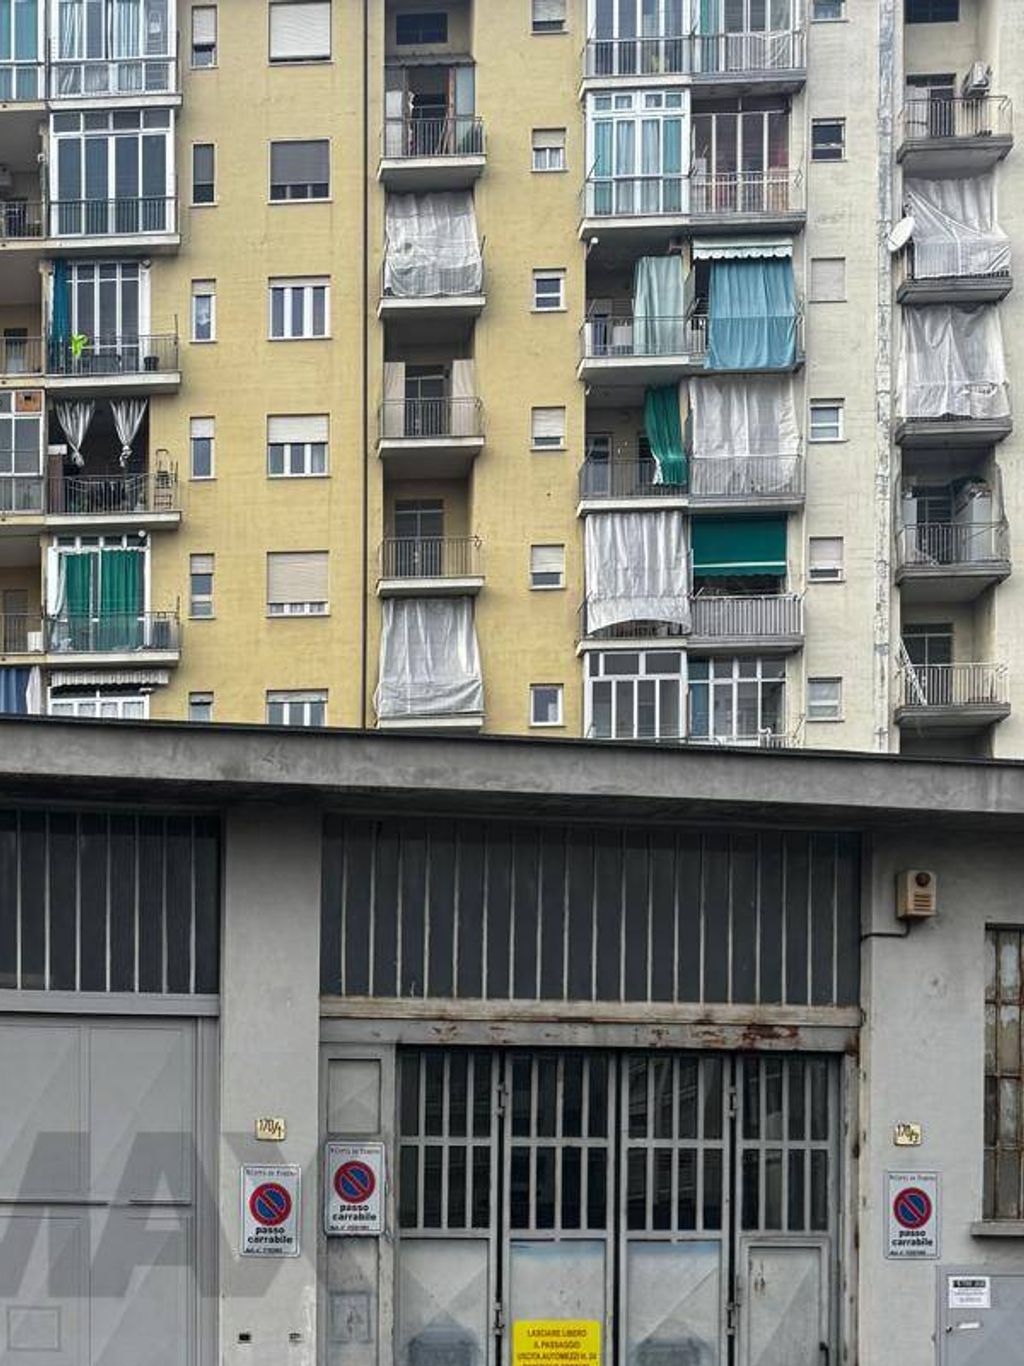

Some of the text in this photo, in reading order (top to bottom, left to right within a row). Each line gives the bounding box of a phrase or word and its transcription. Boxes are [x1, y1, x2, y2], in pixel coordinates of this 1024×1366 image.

[339, 1204, 370, 1213] passo
[332, 1212, 377, 1221] carrabile
[256, 1226, 285, 1236] passo
[898, 1229, 927, 1239] passo
[247, 1235, 293, 1244] carrabile
[891, 1238, 933, 1247] carrabile
